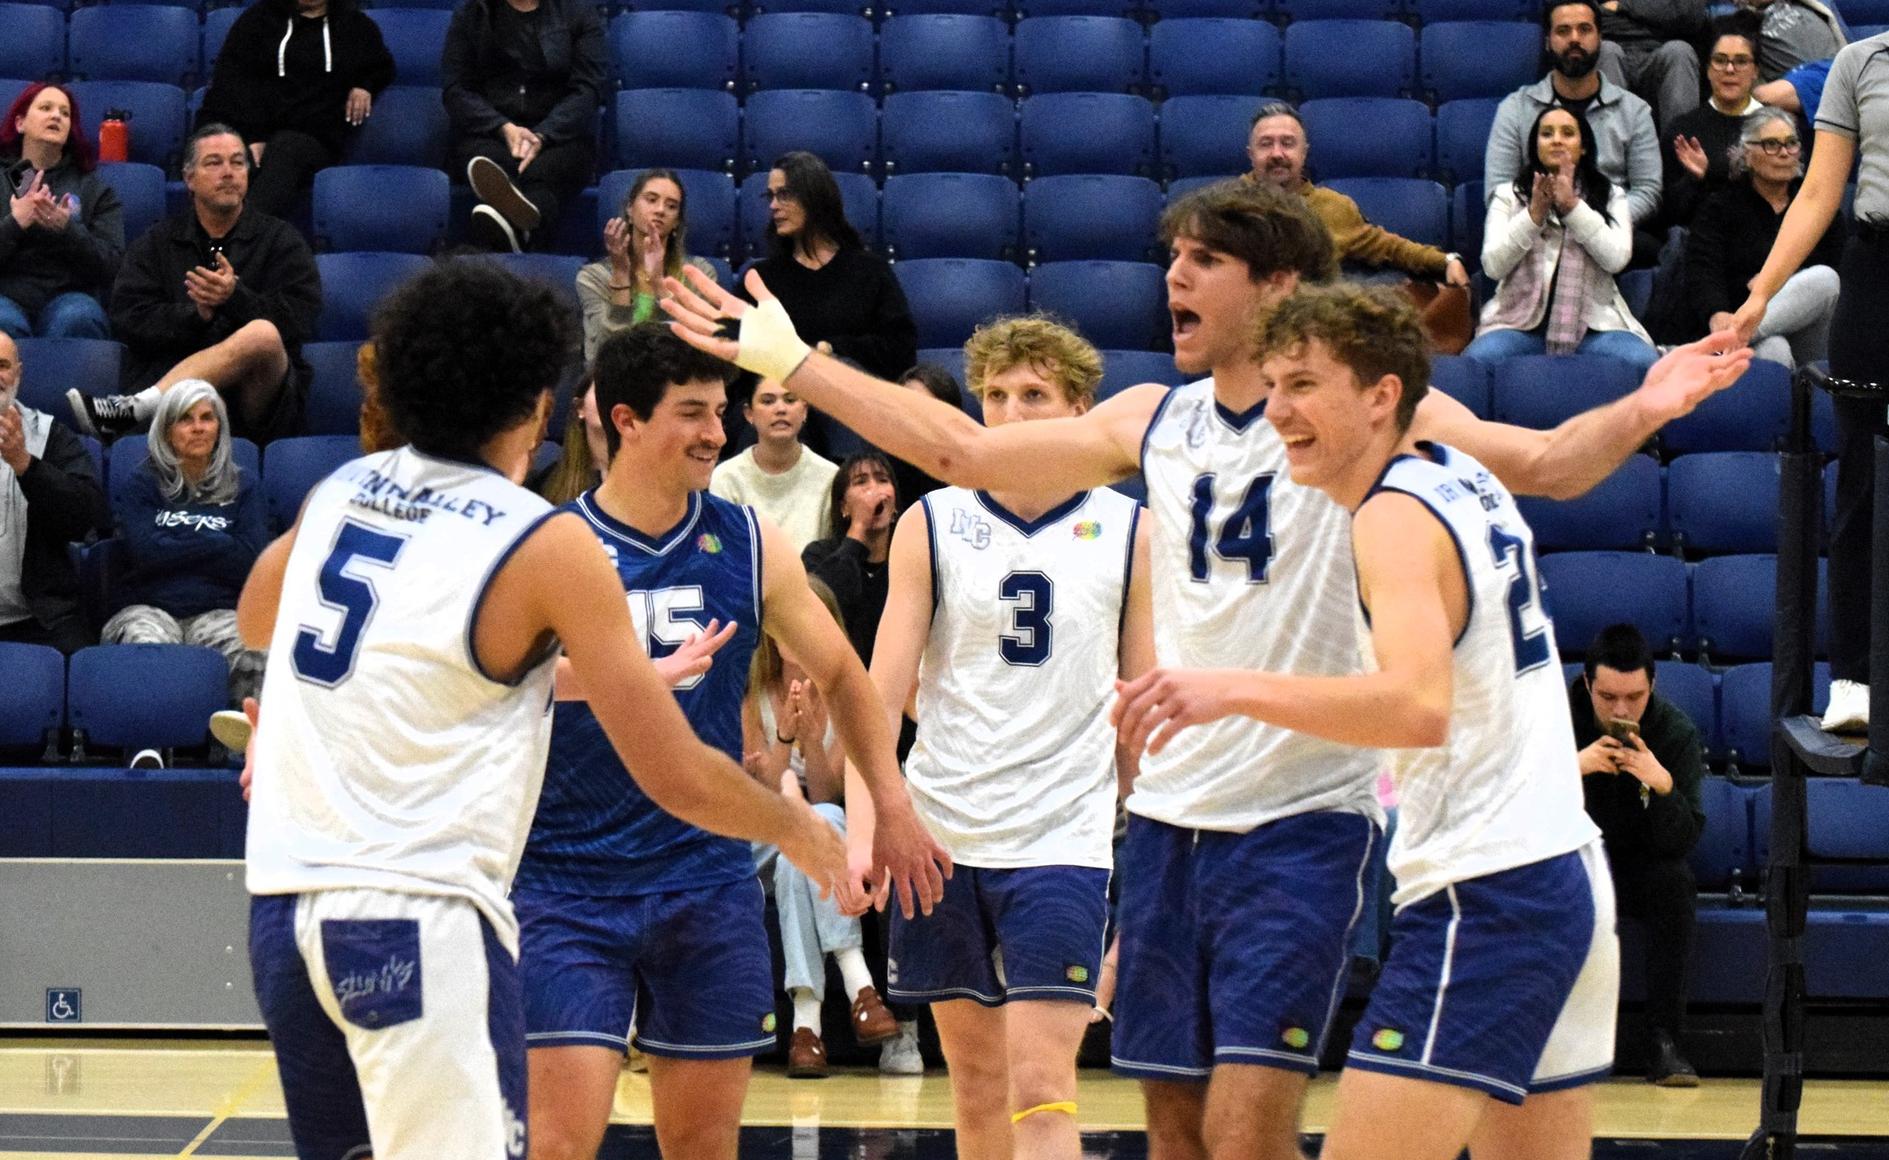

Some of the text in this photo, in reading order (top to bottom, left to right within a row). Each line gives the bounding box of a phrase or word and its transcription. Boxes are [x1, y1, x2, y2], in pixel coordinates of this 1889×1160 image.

[1187, 471, 1277, 585] 14
[289, 515, 413, 690] 5
[998, 570, 1055, 668] 3
